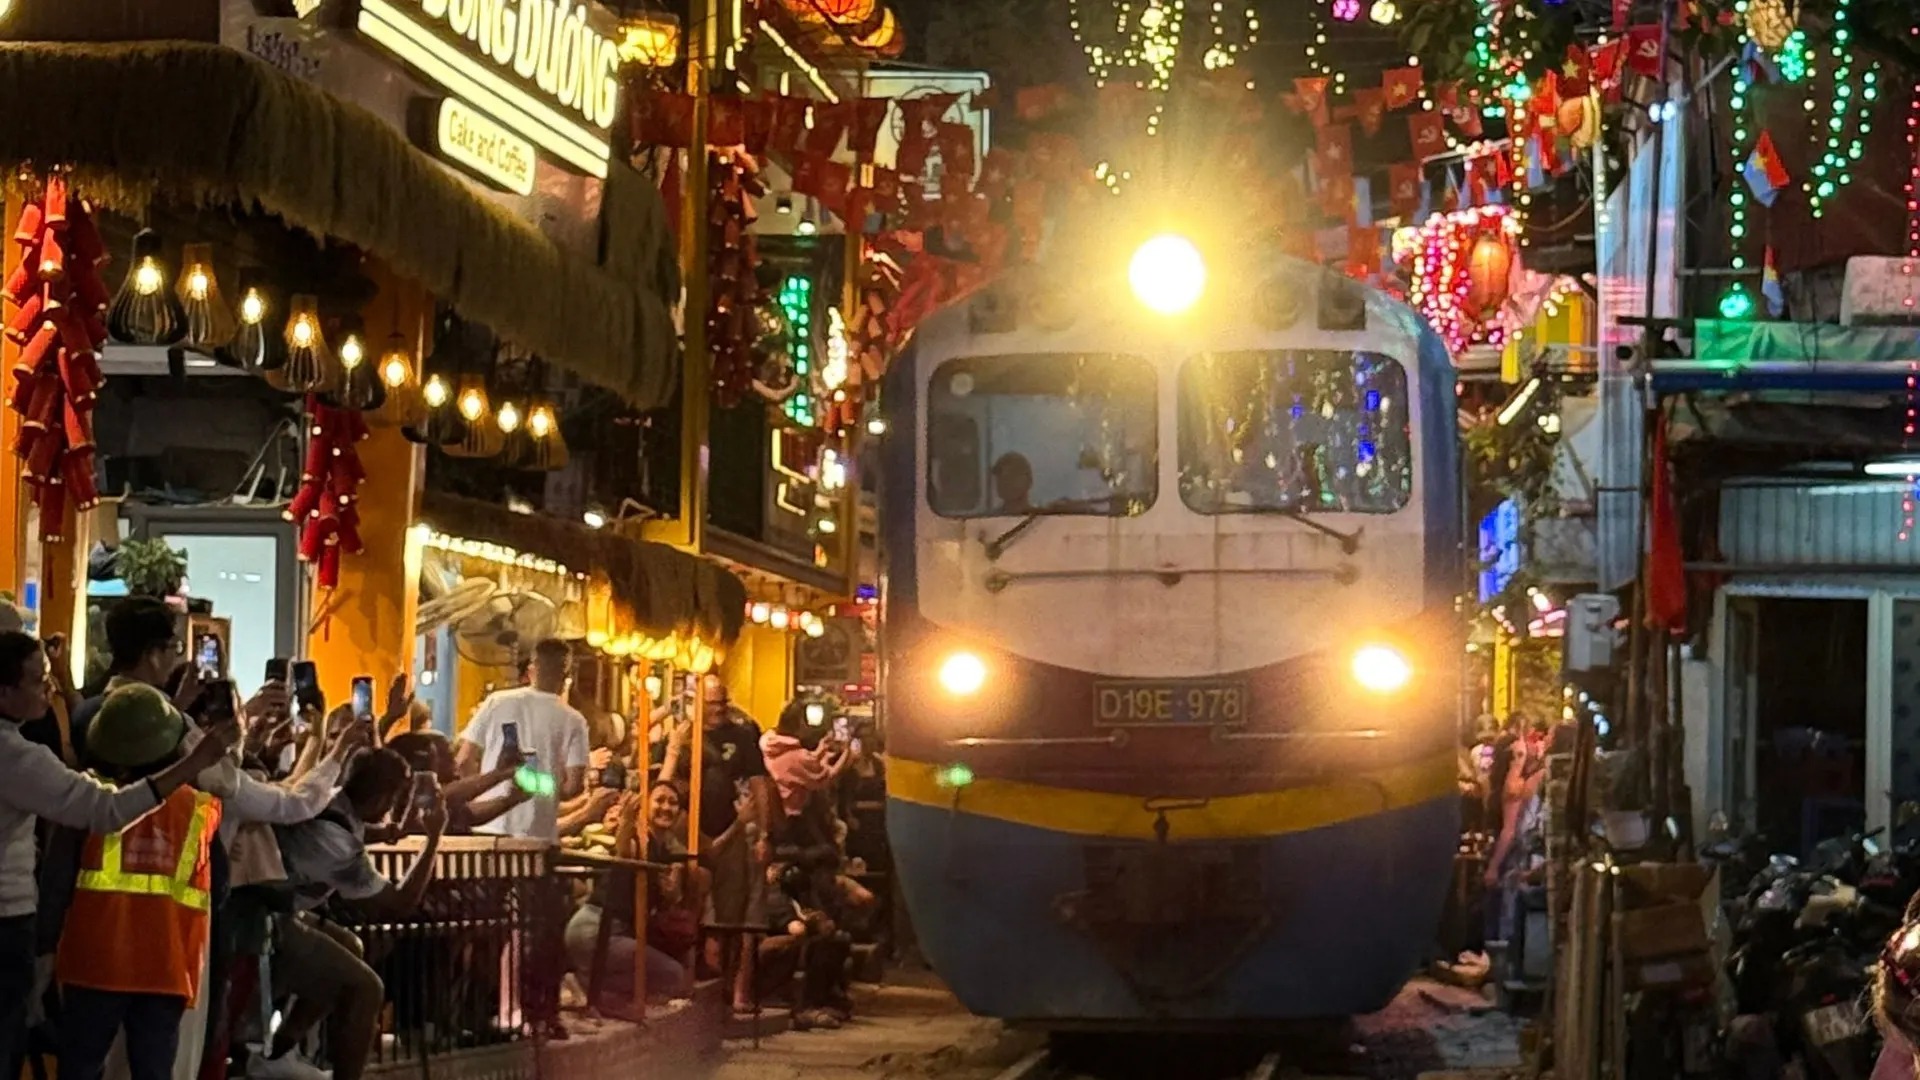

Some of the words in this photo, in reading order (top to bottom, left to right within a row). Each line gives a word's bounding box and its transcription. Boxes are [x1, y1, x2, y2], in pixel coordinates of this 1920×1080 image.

[449, 110, 474, 153] Cake
[477, 132, 496, 165] and
[498, 138, 527, 183] Coffee
